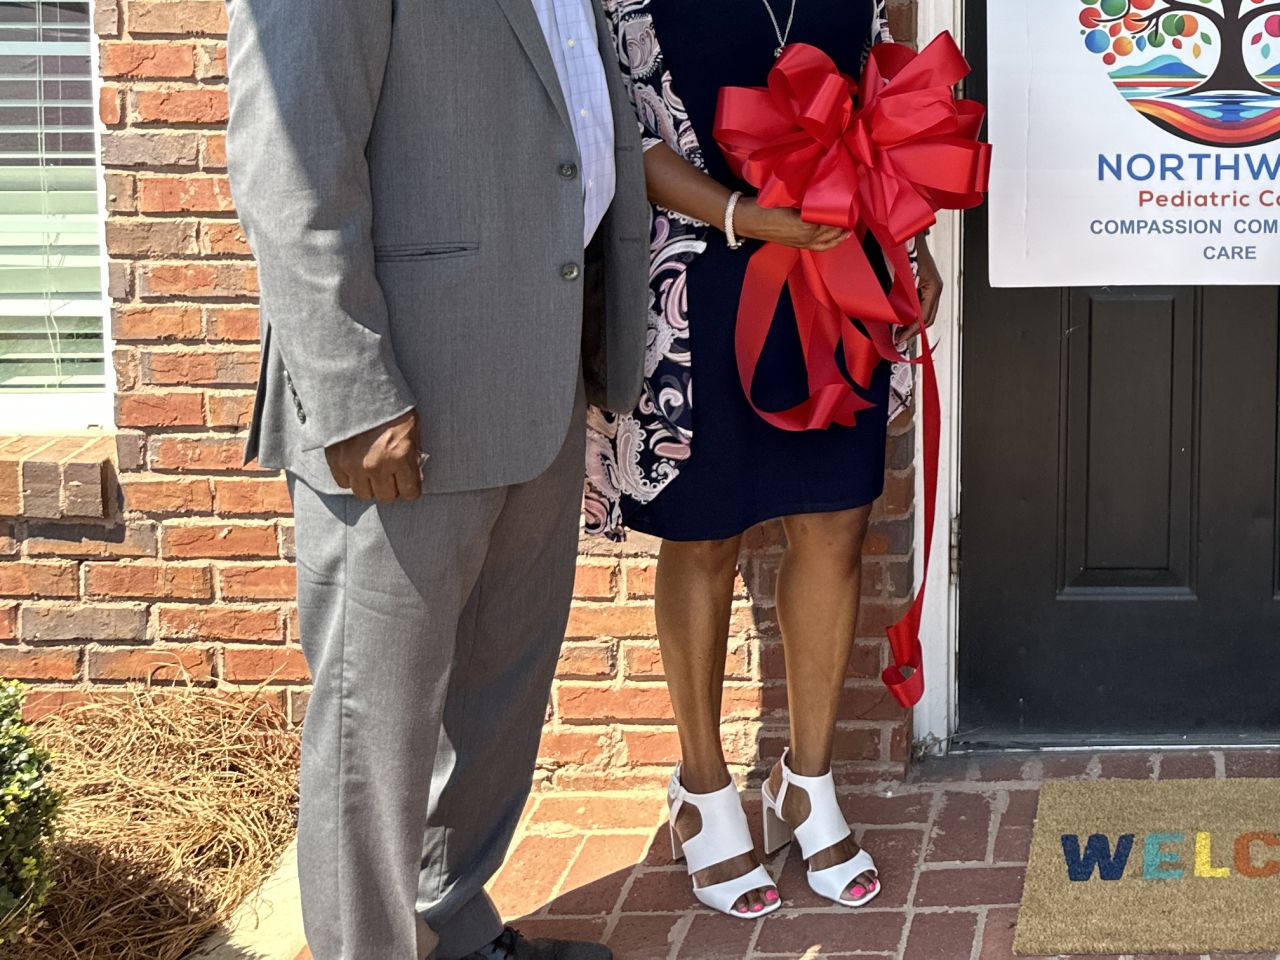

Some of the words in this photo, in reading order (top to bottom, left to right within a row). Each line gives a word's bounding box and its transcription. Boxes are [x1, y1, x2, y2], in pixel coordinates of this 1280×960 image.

[1138, 190, 1250, 207] Pediatric
[1090, 219, 1222, 235] COMPASSION
[1202, 245, 1257, 260] CARE
